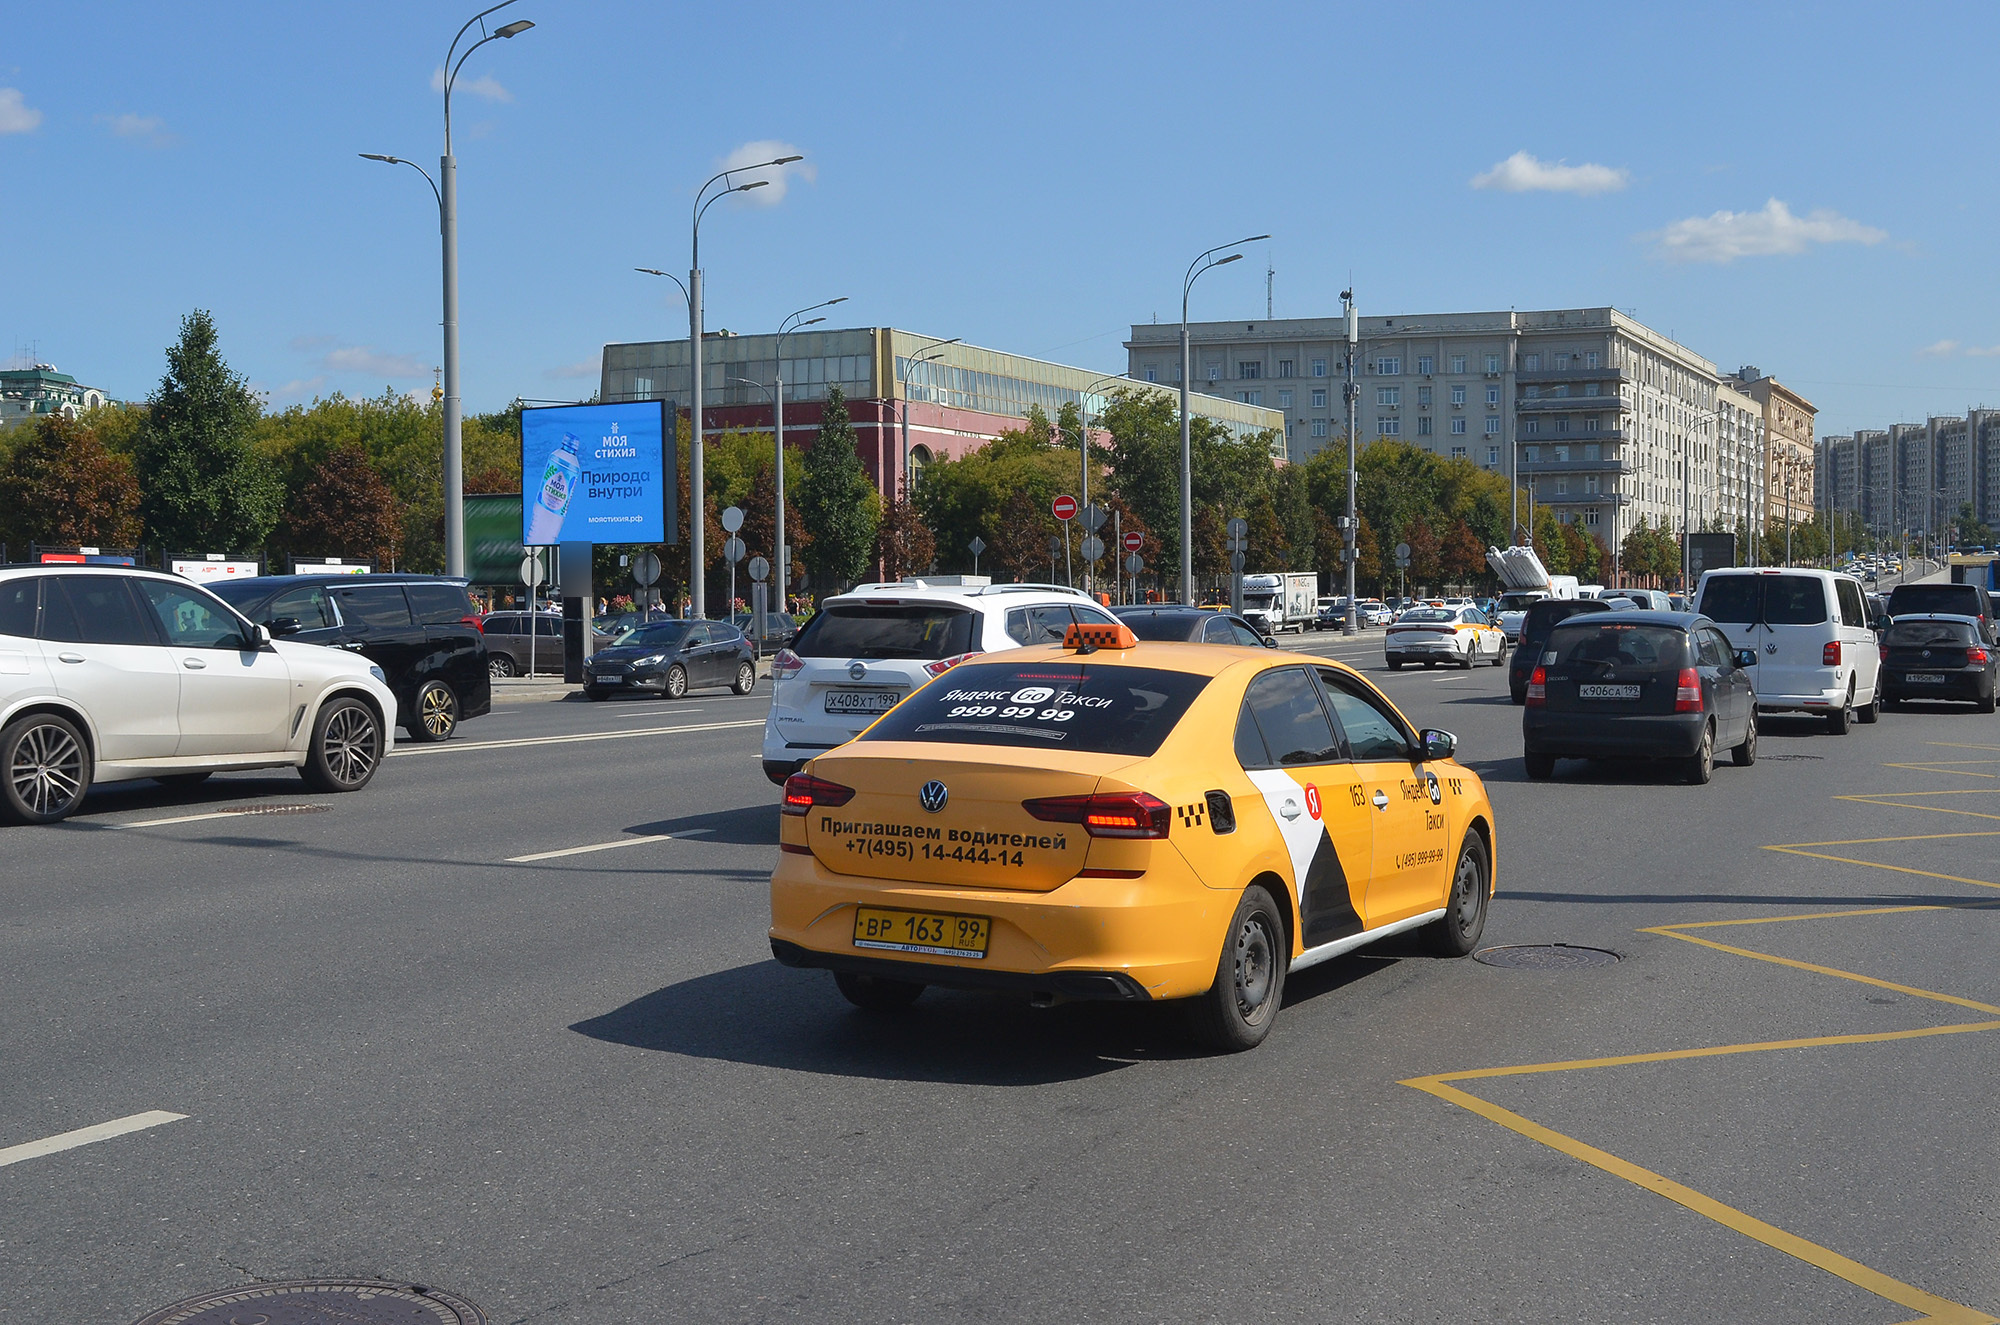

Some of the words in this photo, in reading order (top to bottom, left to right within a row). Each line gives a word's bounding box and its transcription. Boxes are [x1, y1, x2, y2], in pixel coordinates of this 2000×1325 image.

[602, 435, 628, 448] МОЯ
[594, 447, 637, 459] СТИХИЯ
[581, 470, 651, 486] Природа
[588, 486, 643, 500] внутри
[588, 514, 644, 524] моястихия.рф
[939, 689, 1011, 702] Яндекс
[1054, 690, 1114, 709] Такси
[1582, 686, 1621, 696] К906СА
[1623, 686, 1638, 695] 199
[829, 694, 874, 708] Х408ХТ
[877, 694, 895, 705] 199
[947, 705, 997, 718] 999
[998, 706, 1036, 719] 99
[1037, 708, 1075, 722] 99
[1350, 784, 1366, 807] 163
[1400, 779, 1429, 803] Яндекс
[1309, 788, 1319, 814] Я
[1425, 810, 1445, 831] Такси
[821, 816, 941, 840] Приглашаем
[948, 826, 1067, 850] водителей
[846, 838, 914, 862] +7(495)
[921, 843, 1024, 867] 14-444-14
[1401, 851, 1417, 870] (495)
[1417, 848, 1444, 866] 999-99-99
[866, 918, 892, 937] ВР
[905, 916, 945, 942] 163
[958, 920, 980, 940] 99
[958, 939, 976, 948] RUS
